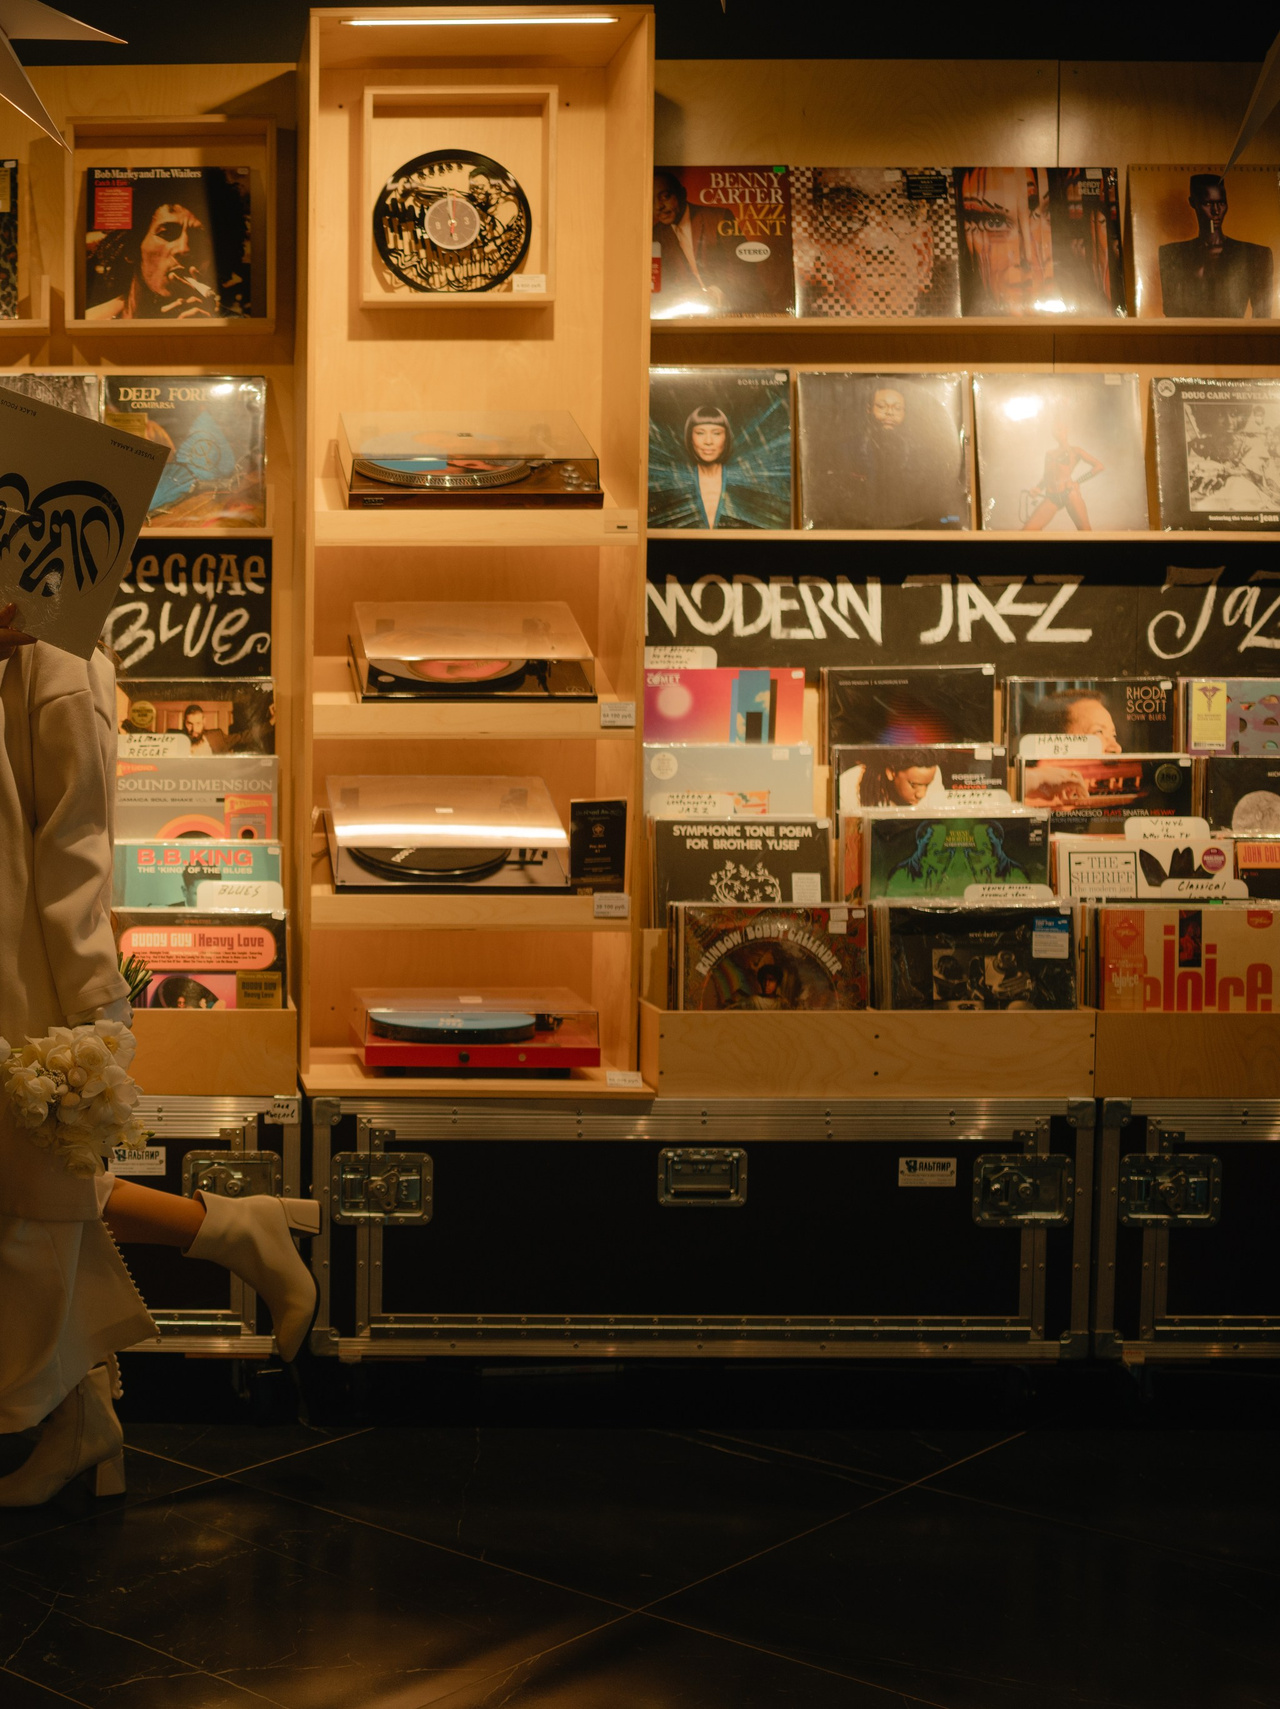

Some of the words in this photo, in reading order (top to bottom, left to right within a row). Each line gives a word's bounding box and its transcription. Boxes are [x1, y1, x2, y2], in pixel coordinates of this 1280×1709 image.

[94, 169, 112, 179] Bob
[112, 169, 137, 180] Marley
[139, 169, 154, 178] and
[155, 169, 170, 178] The
[171, 168, 202, 178] Wailers
[710, 172, 783, 189] BENNY
[699, 188, 785, 204] CARTER
[738, 203, 786, 220] JAZZ
[717, 220, 787, 237] GIANT
[738, 247, 769, 256] STEREO
[119, 387, 161, 402] DEEP
[1181, 391, 1205, 400] DOUG
[1207, 391, 1231, 400] CARN
[0, 399, 18, 411] FOCUS
[19, 406, 38, 417] BLACK
[131, 401, 175, 409] COMPARSA
[133, 448, 155, 461] YUSSEF
[1260, 513, 1279, 523] jean
[646, 574, 883, 646] MODERN
[902, 574, 1093, 643] JAZZ
[1126, 685, 1167, 700] RHODA
[1126, 700, 1167, 713] SCOTT
[952, 773, 986, 781] ROBERT
[117, 779, 176, 791] SOUND
[179, 779, 273, 791] DIMENSION
[1122, 809, 1149, 817] SINATRA
[673, 825, 741, 837] SYMPHONIC
[744, 825, 775, 837] TONE
[779, 825, 813, 838] POEM
[686, 839, 709, 850] FOR
[713, 839, 763, 850] BROTHER
[766, 839, 800, 851] YUSEF
[137, 849, 253, 866] B.B.KING
[1243, 846, 1262, 863] JOHN
[1087, 856, 1118, 868] THE
[1071, 871, 1135, 884] SHERIFF
[218, 885, 262, 898] BLUES
[1177, 880, 1227, 892] Classical
[131, 932, 168, 948] BUDDY
[170, 932, 192, 948] GUY
[198, 933, 234, 950] Heavy
[237, 933, 265, 948] Love
[695, 930, 743, 976] RAINBOW
[745, 925, 785, 940] BOBBY
[787, 926, 843, 975] CALLENDER
[919, 1161, 951, 1172] АЛЬТАИР
